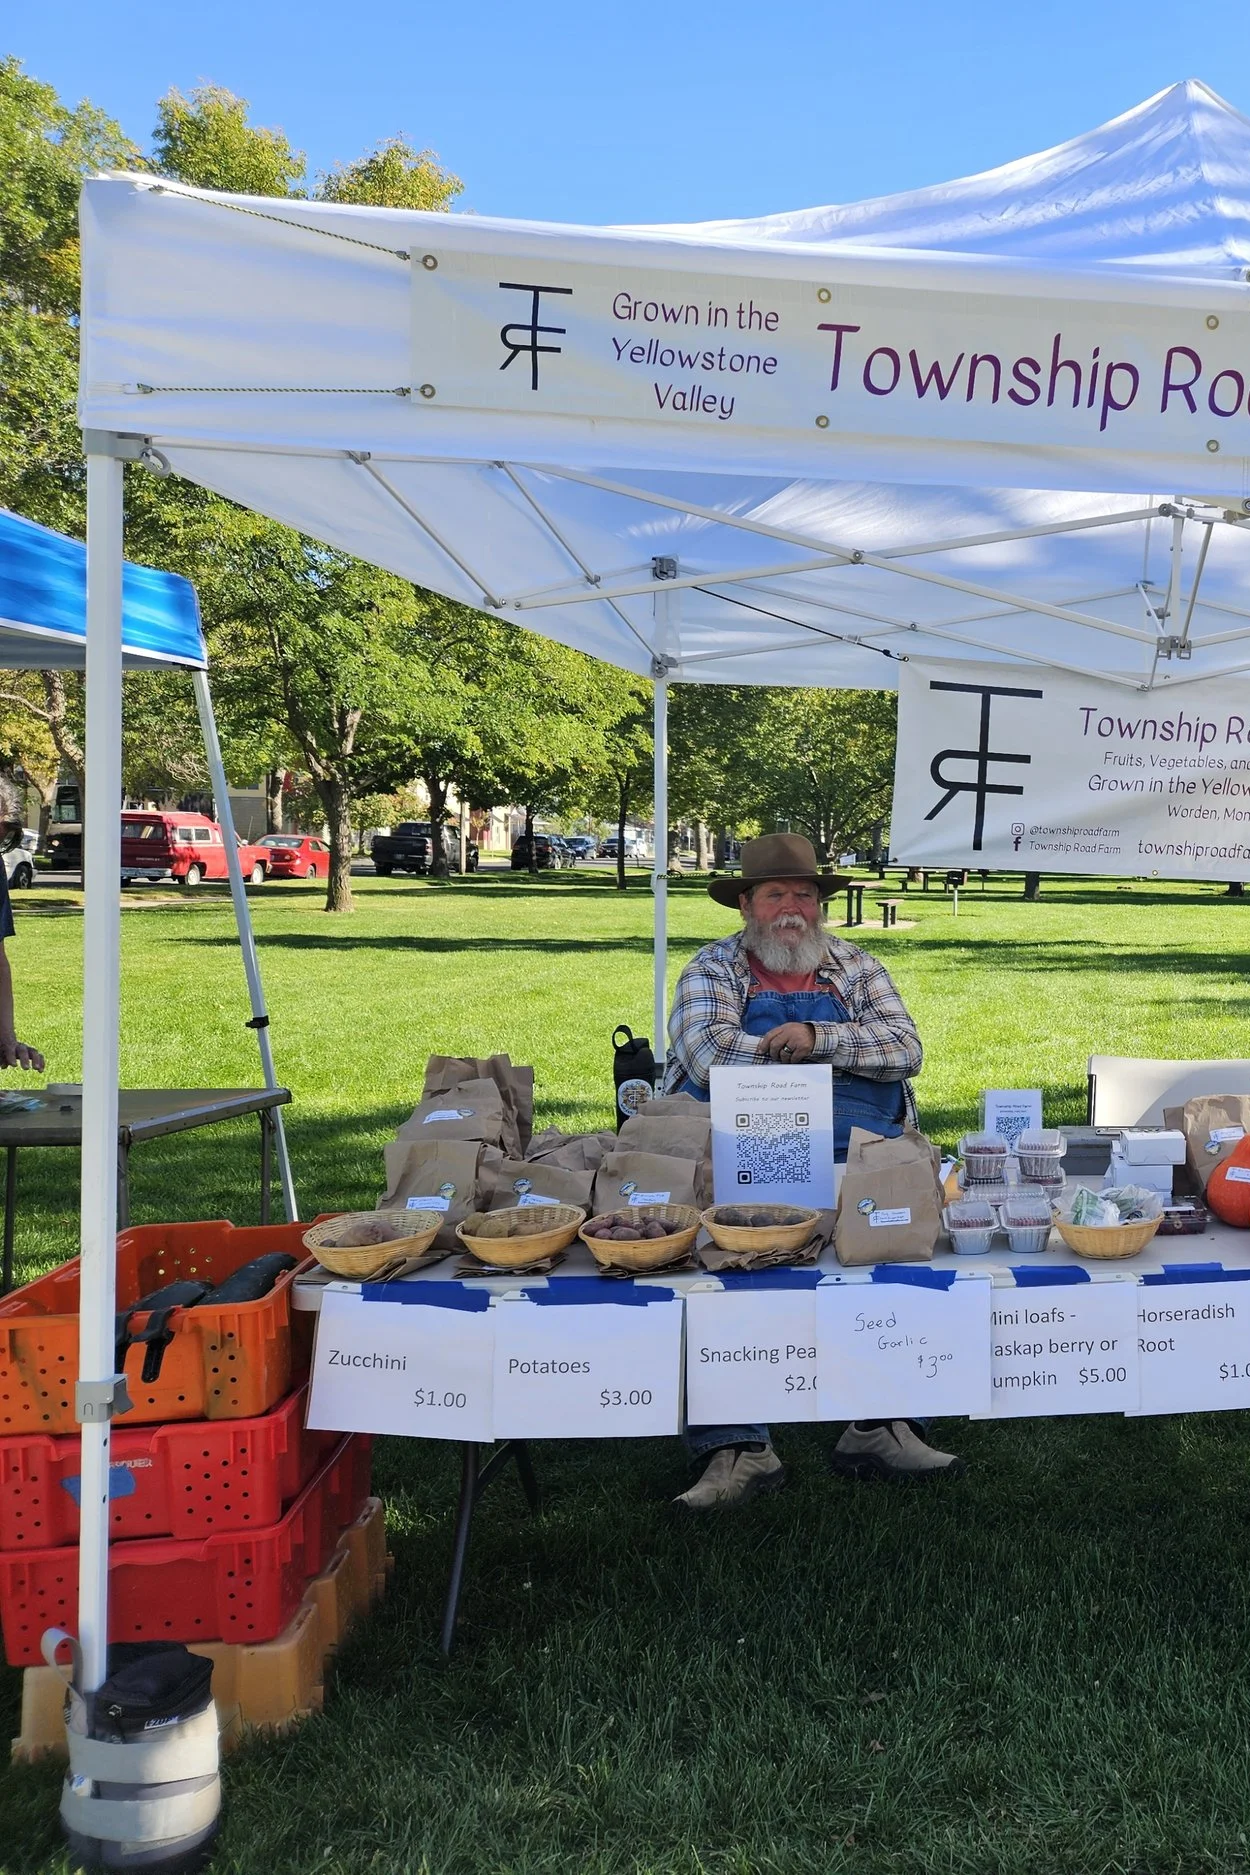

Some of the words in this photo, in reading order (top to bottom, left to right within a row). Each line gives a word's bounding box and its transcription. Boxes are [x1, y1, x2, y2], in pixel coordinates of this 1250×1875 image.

[612, 292, 699, 326] Grown
[707, 302, 728, 329] in
[737, 300, 779, 332] the
[612, 337, 778, 375] Yellowstone
[817, 323, 1140, 432] Township
[653, 383, 735, 420] Valley
[1079, 706, 1217, 751] Township
[1103, 752, 1146, 769] Fruits,
[1150, 755, 1227, 773] Vegetables,
[1088, 775, 1144, 794] Grown
[1148, 779, 1164, 795] in
[1168, 777, 1196, 796] the
[1167, 805, 1219, 823] Worden,
[1029, 825, 1120, 839] @townshiproadfarm
[1029, 840, 1071, 854] Township
[1073, 842, 1098, 854] Road
[1100, 843, 1121, 855] Farm
[737, 1082, 768, 1090] Township
[770, 1081, 788, 1089] Road
[790, 1081, 807, 1089] Farm
[854, 1311, 897, 1332] Seed
[1024, 1307, 1065, 1325] loafs
[877, 1334, 928, 1351] Garlic
[992, 1340, 1043, 1358] askap
[1049, 1338, 1095, 1356] berry
[1100, 1339, 1118, 1351] or
[1137, 1338, 1176, 1353] Root
[328, 1349, 407, 1372] Zucchini
[700, 1346, 780, 1364] Snacking
[786, 1345, 817, 1360] Pea
[508, 1355, 591, 1376] Potatoes
[784, 1374, 817, 1394] $2.
[993, 1370, 1057, 1390] umpkin
[1078, 1367, 1127, 1386] $5.00
[413, 1387, 467, 1409] $1.00
[600, 1387, 653, 1409] $3.00
